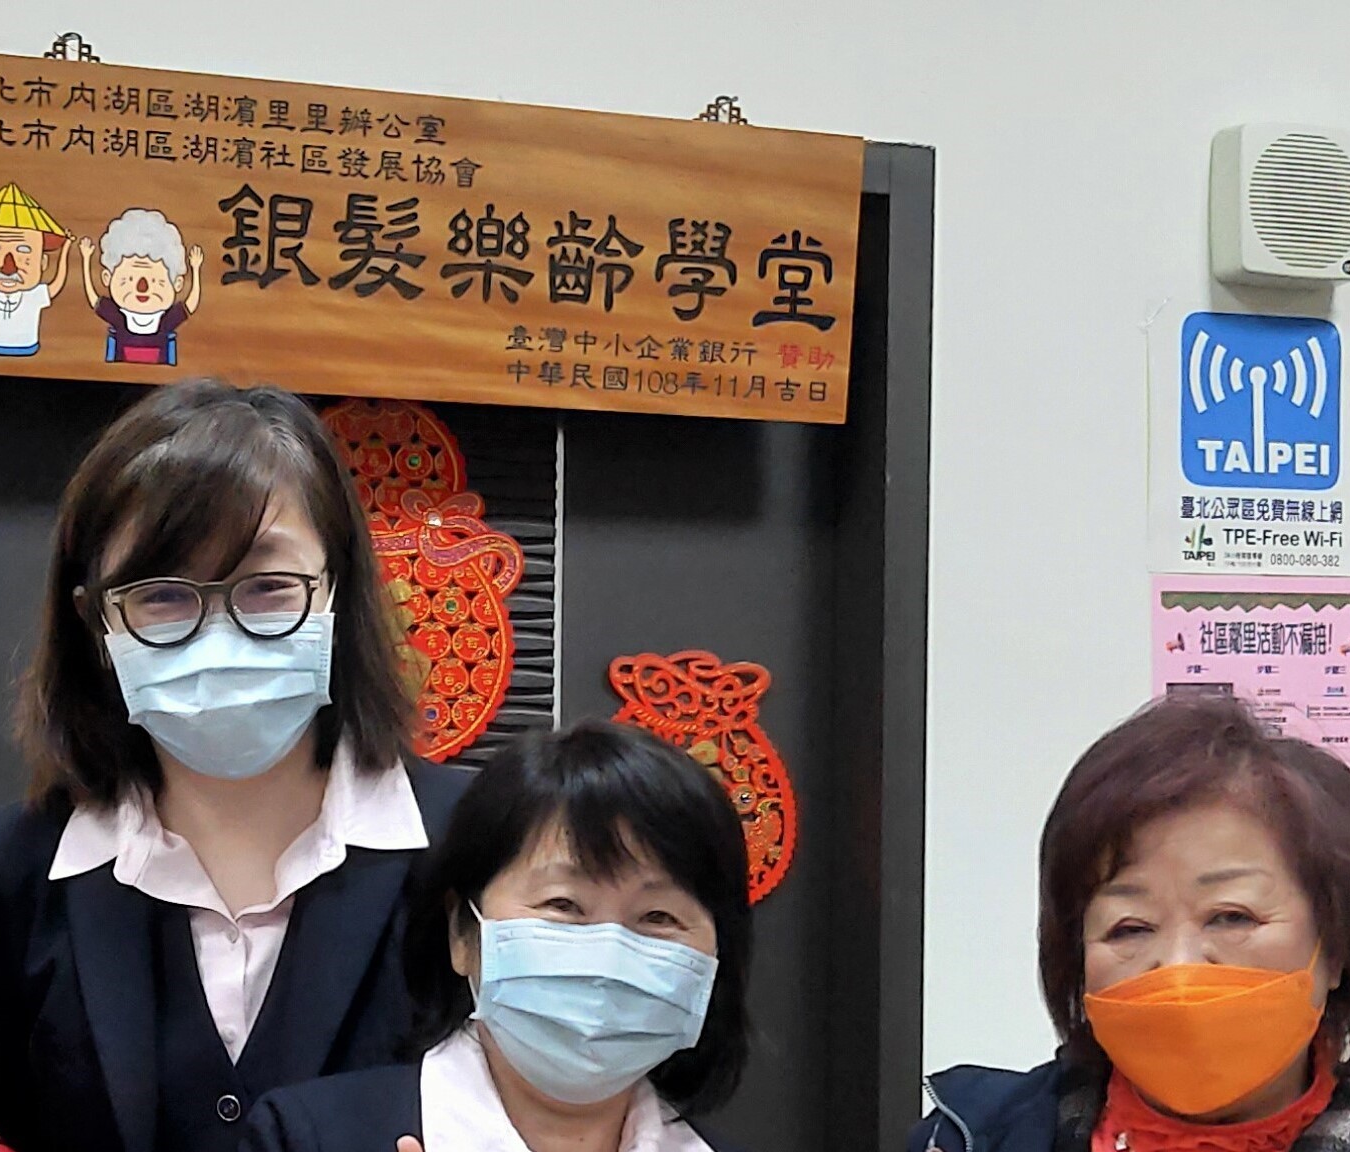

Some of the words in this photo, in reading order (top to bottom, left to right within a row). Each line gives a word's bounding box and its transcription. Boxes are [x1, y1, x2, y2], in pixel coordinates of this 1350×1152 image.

[219, 183, 836, 332] 銀髮樂齡學堂
[505, 325, 758, 367] 臺灣中小企業銀行
[507, 359, 828, 402] 中華民國108年11月吉日
[1197, 439, 1330, 477] TAIPEI
[1222, 528, 1300, 547] TPE-Free
[1304, 530, 1343, 548] Wi-Fi
